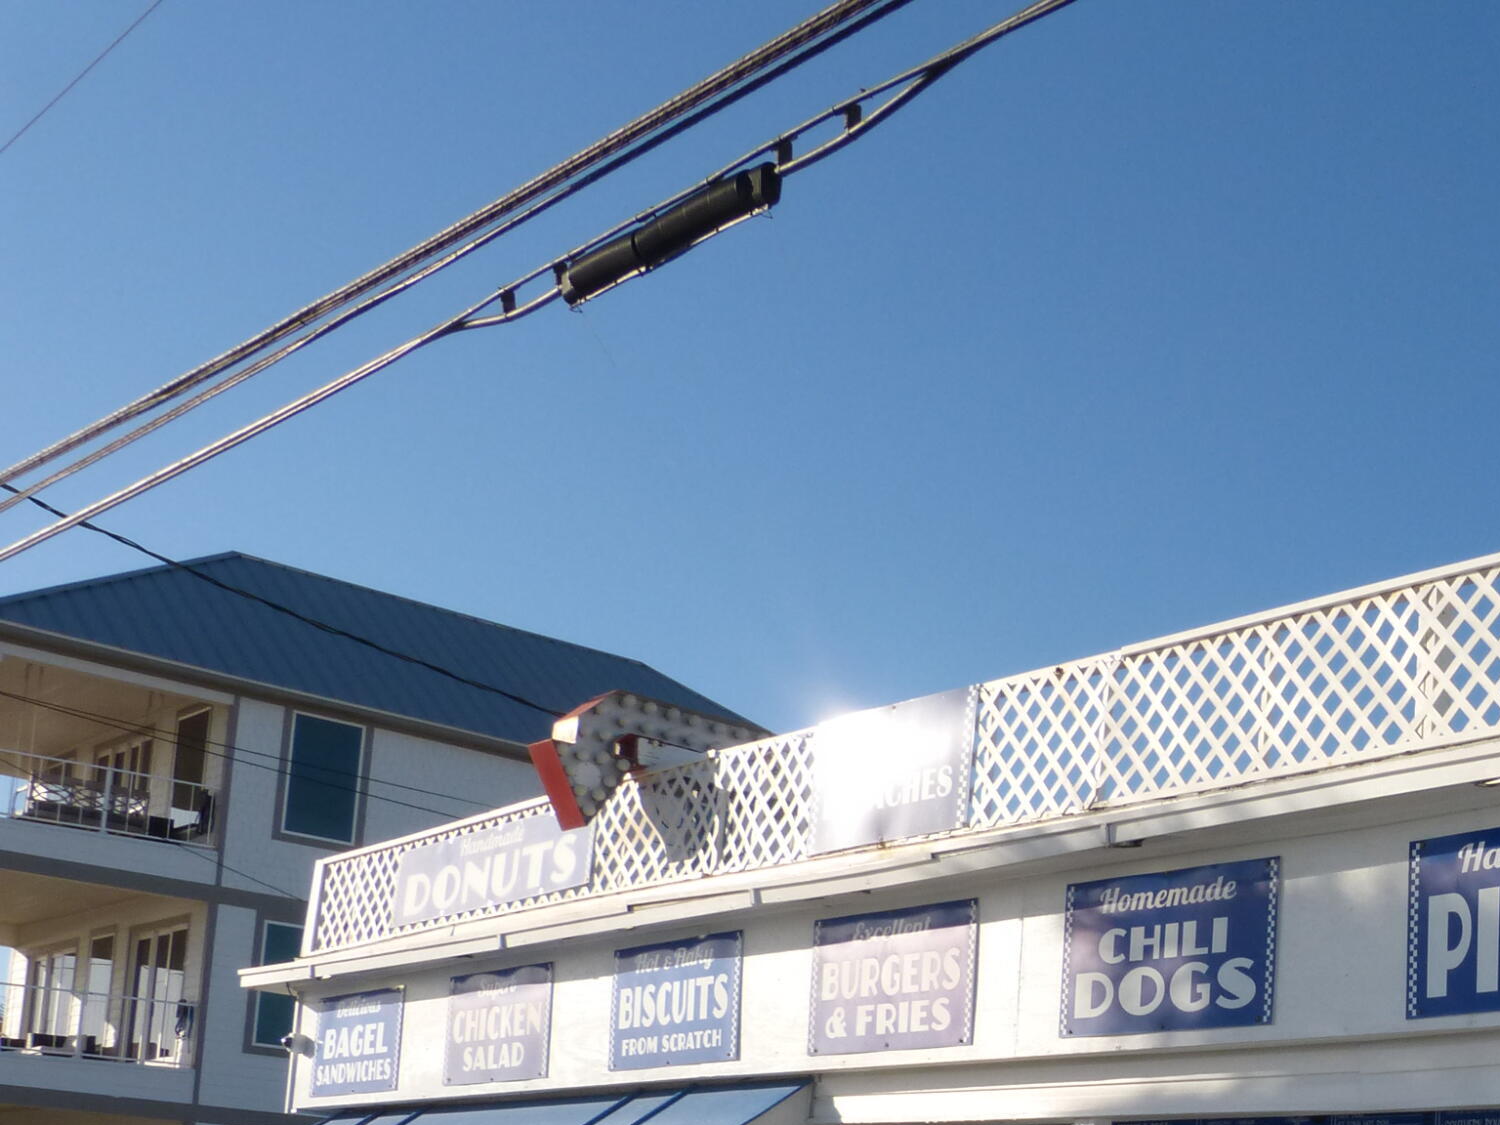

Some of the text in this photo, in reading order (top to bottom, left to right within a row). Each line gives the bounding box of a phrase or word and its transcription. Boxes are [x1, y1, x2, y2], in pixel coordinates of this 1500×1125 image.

[402, 832, 578, 918] DONUTS
[1099, 875, 1238, 915] Homemade
[1097, 916, 1228, 965] CHILI
[821, 946, 962, 1001] BURGERS
[1074, 956, 1257, 1020] DOGS
[452, 1001, 543, 1045] CHICKEN
[618, 973, 729, 1031] BISCUITS
[825, 997, 951, 1039] & FRIES
[322, 1021, 389, 1060] BAGEL
[462, 1041, 526, 1073] SALAD
[621, 1028, 723, 1057] FROM SCRATCH
[315, 1058, 391, 1087] SANDWICHES
